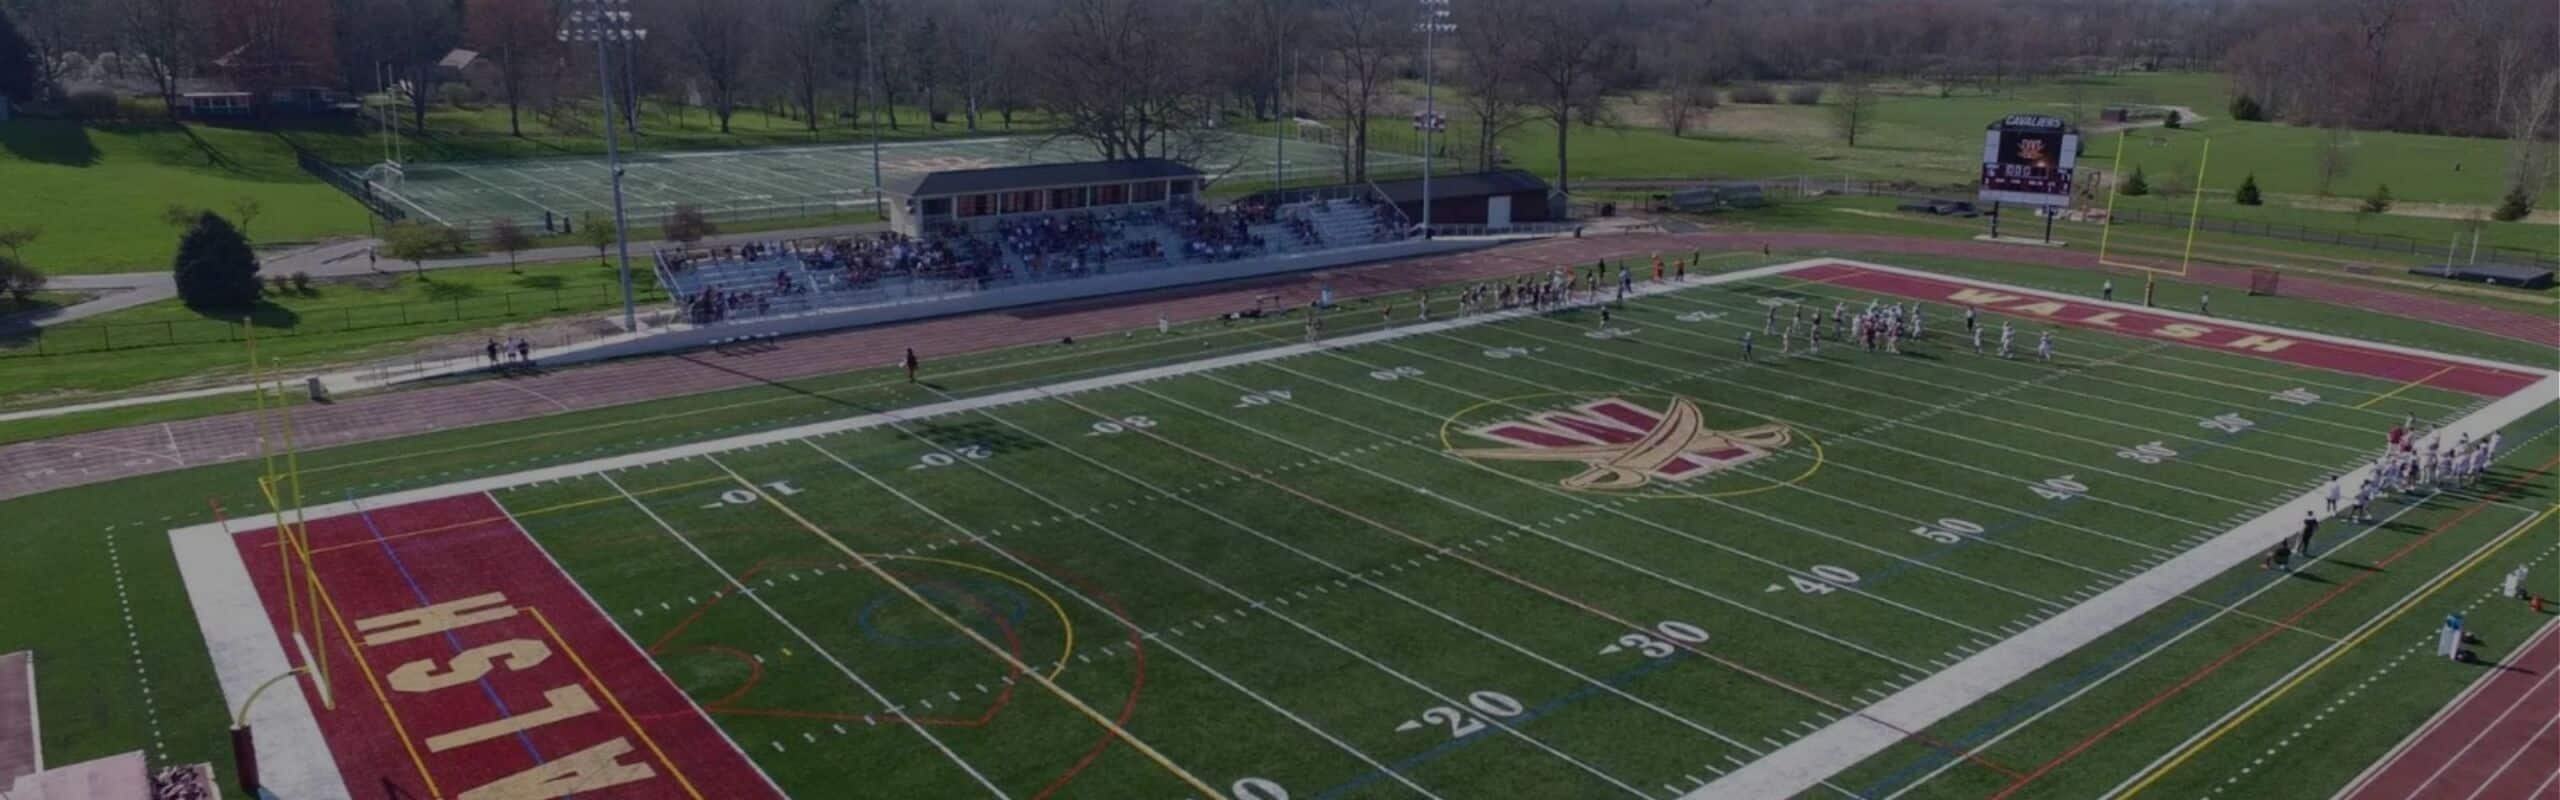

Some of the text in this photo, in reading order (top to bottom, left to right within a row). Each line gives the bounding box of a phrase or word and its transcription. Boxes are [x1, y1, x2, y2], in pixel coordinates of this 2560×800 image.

[2005, 114, 2061, 129] CAVALIERS
[1947, 288, 2298, 353] WALSH
[1093, 415, 1158, 435] 30
[920, 441, 993, 467] 20
[721, 479, 805, 504] 10
[2027, 478, 2089, 500] 40
[1910, 517, 1985, 544] 50
[1788, 565, 1860, 595] 40
[1619, 620, 1709, 658] 30
[354, 591, 657, 800] ALSH
[1422, 690, 1524, 738] 20
[1232, 777, 1289, 800] 0
